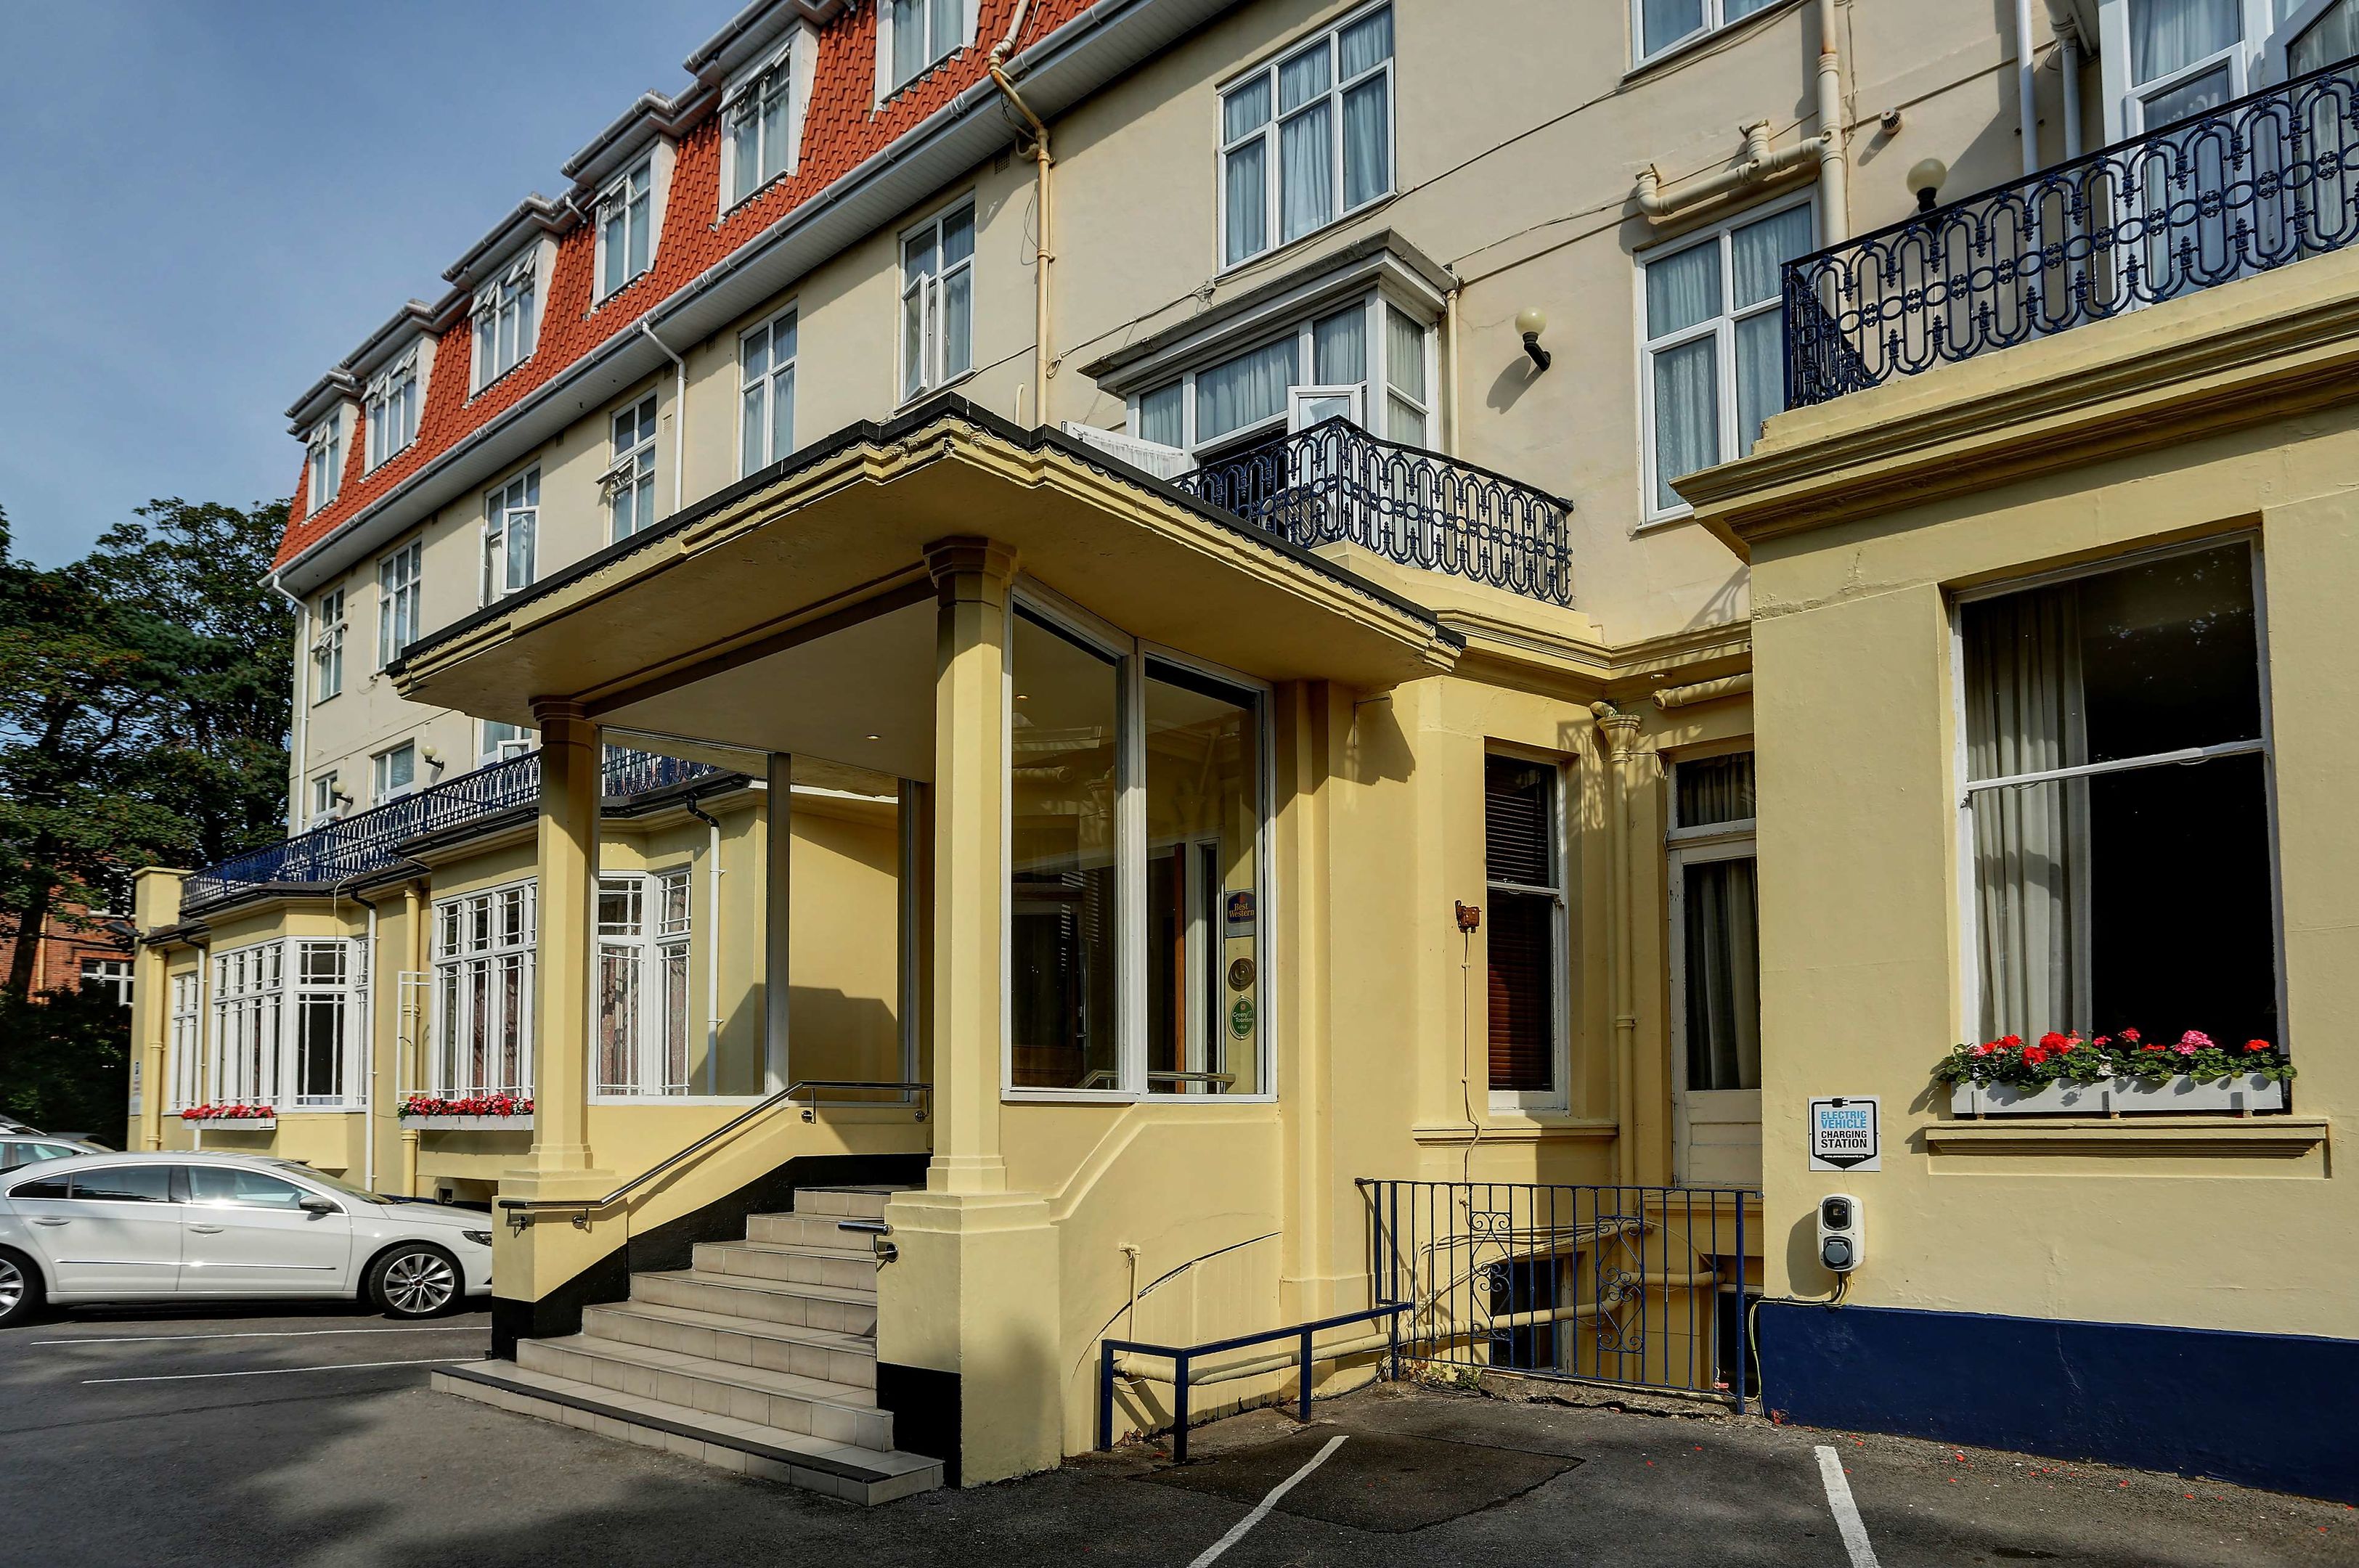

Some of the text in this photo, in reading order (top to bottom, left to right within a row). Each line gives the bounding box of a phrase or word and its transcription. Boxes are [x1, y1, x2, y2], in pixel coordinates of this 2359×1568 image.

[1821, 1111, 1866, 1119] ELECTRIC
[1821, 1119, 1866, 1129] VEHICLE
[1821, 1138, 1867, 1148] STATION
